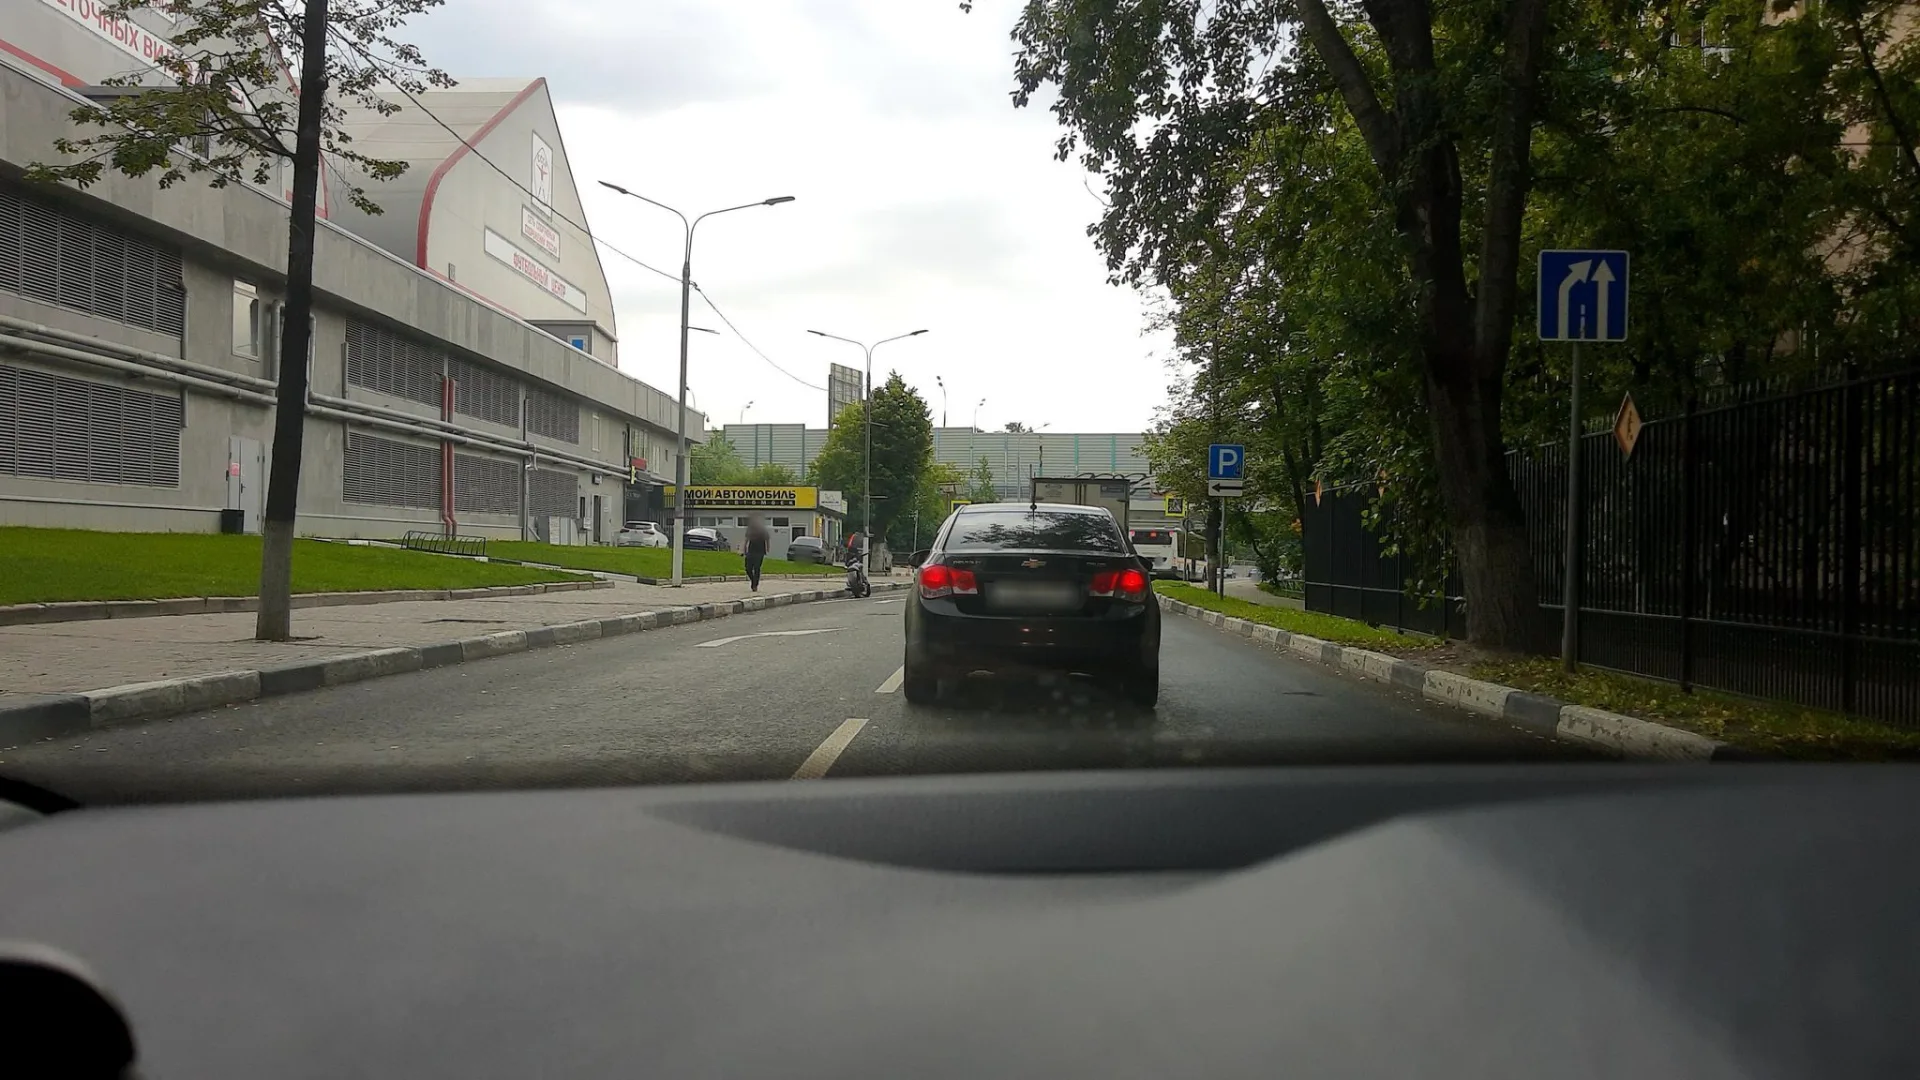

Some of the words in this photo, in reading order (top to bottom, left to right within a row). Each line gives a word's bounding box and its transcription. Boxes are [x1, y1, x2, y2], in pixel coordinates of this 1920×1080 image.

[513, 252, 549, 287] ФУТБОЛЬНЫЙ
[550, 279, 566, 299] ЦЕНТР
[1218, 449, 1238, 475] P
[715, 489, 796, 499] АВТОМОБИЛЬ
